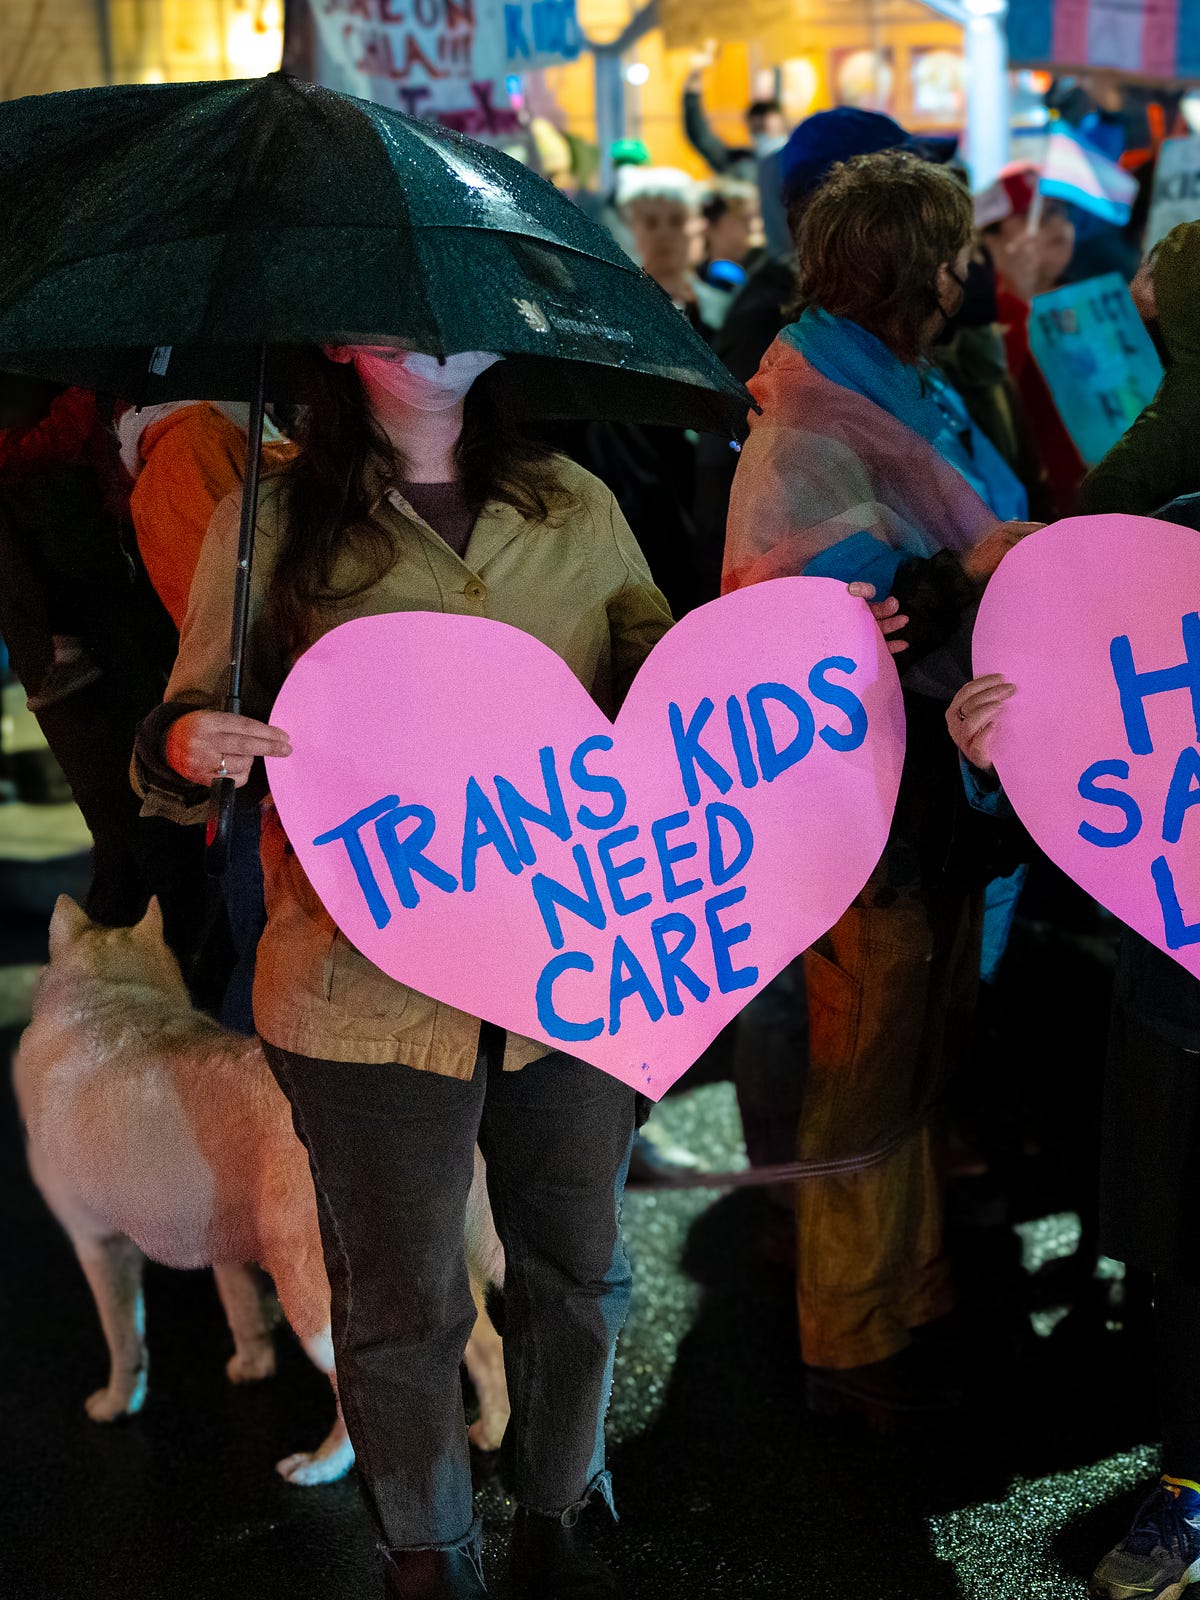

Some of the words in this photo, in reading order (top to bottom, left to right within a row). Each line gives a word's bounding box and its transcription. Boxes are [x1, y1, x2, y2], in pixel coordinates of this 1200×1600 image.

[312, 735, 628, 929] TRANS
[668, 656, 868, 807] KIDS
[531, 802, 754, 950] NEED
[536, 886, 760, 1042] CARE
